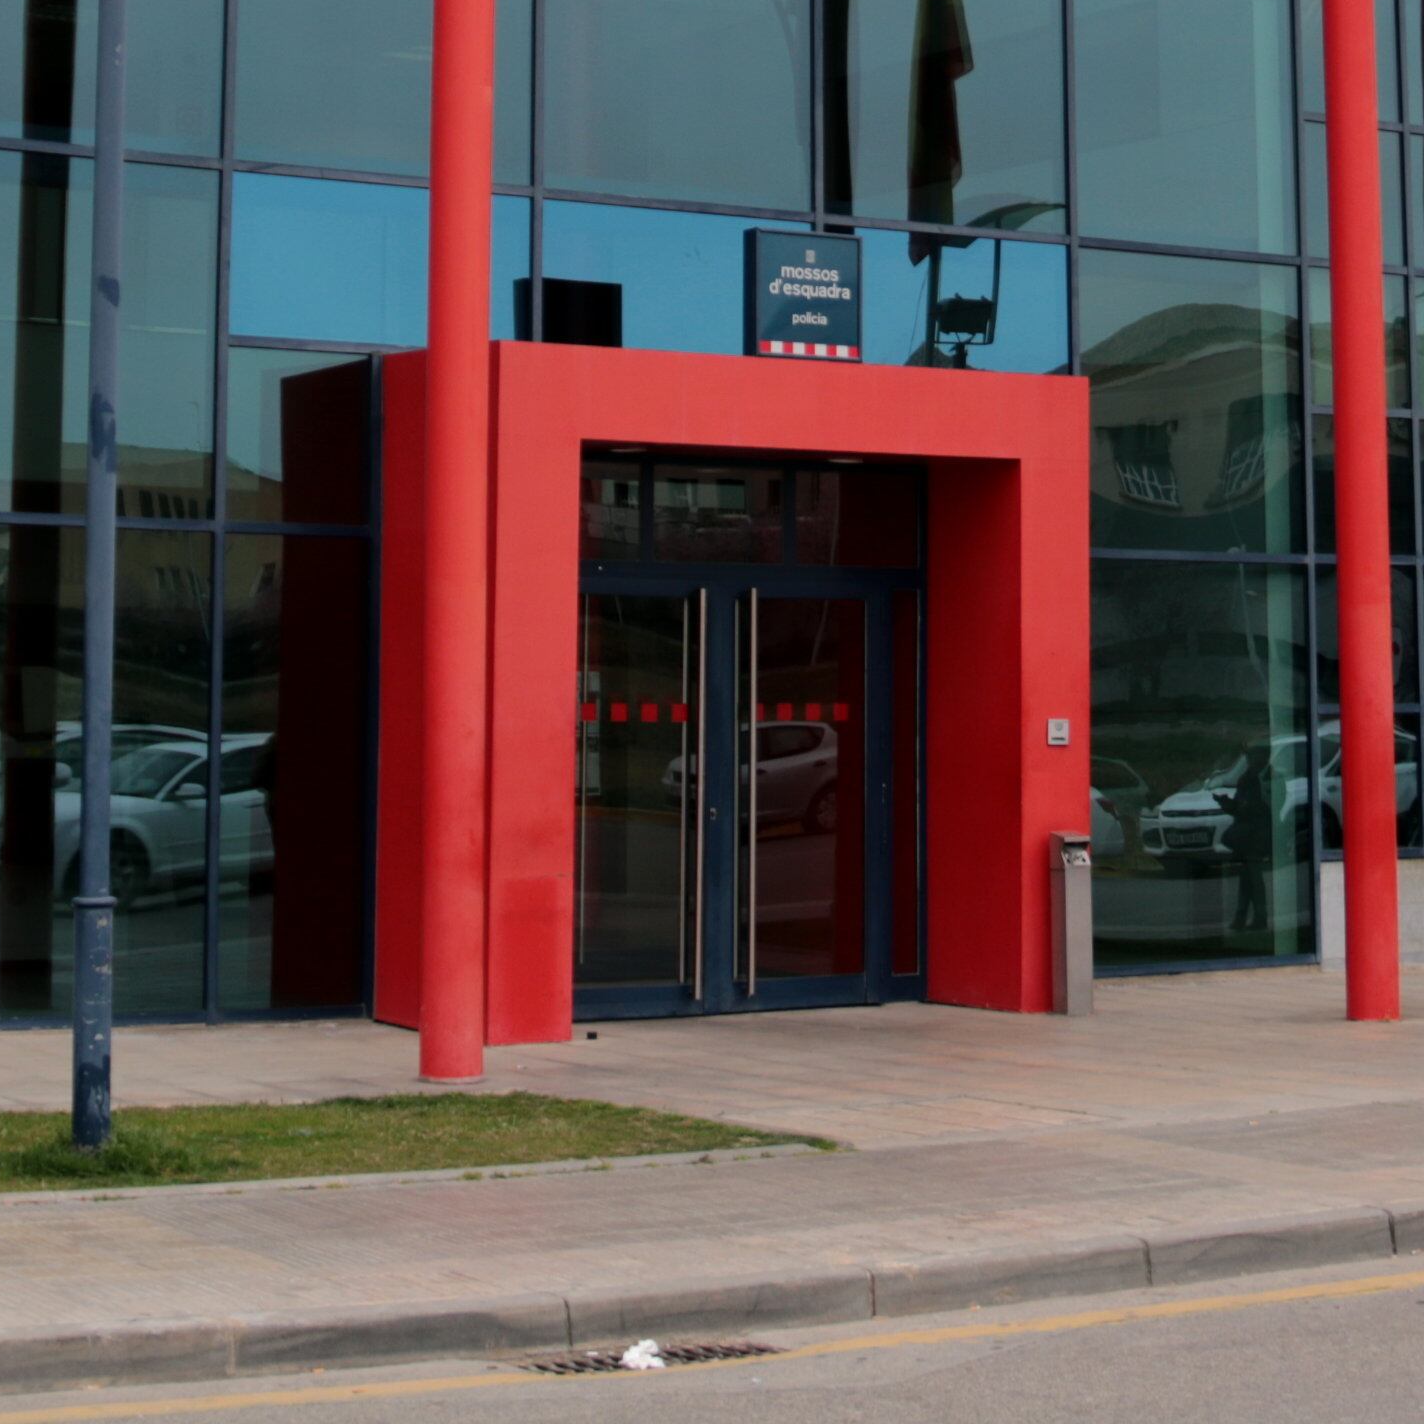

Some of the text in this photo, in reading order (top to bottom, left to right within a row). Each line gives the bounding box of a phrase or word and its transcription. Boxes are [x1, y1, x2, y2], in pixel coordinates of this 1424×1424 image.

[780, 265, 839, 282] mossos
[769, 278, 851, 300] d'esquadra
[792, 312, 828, 326] policia
